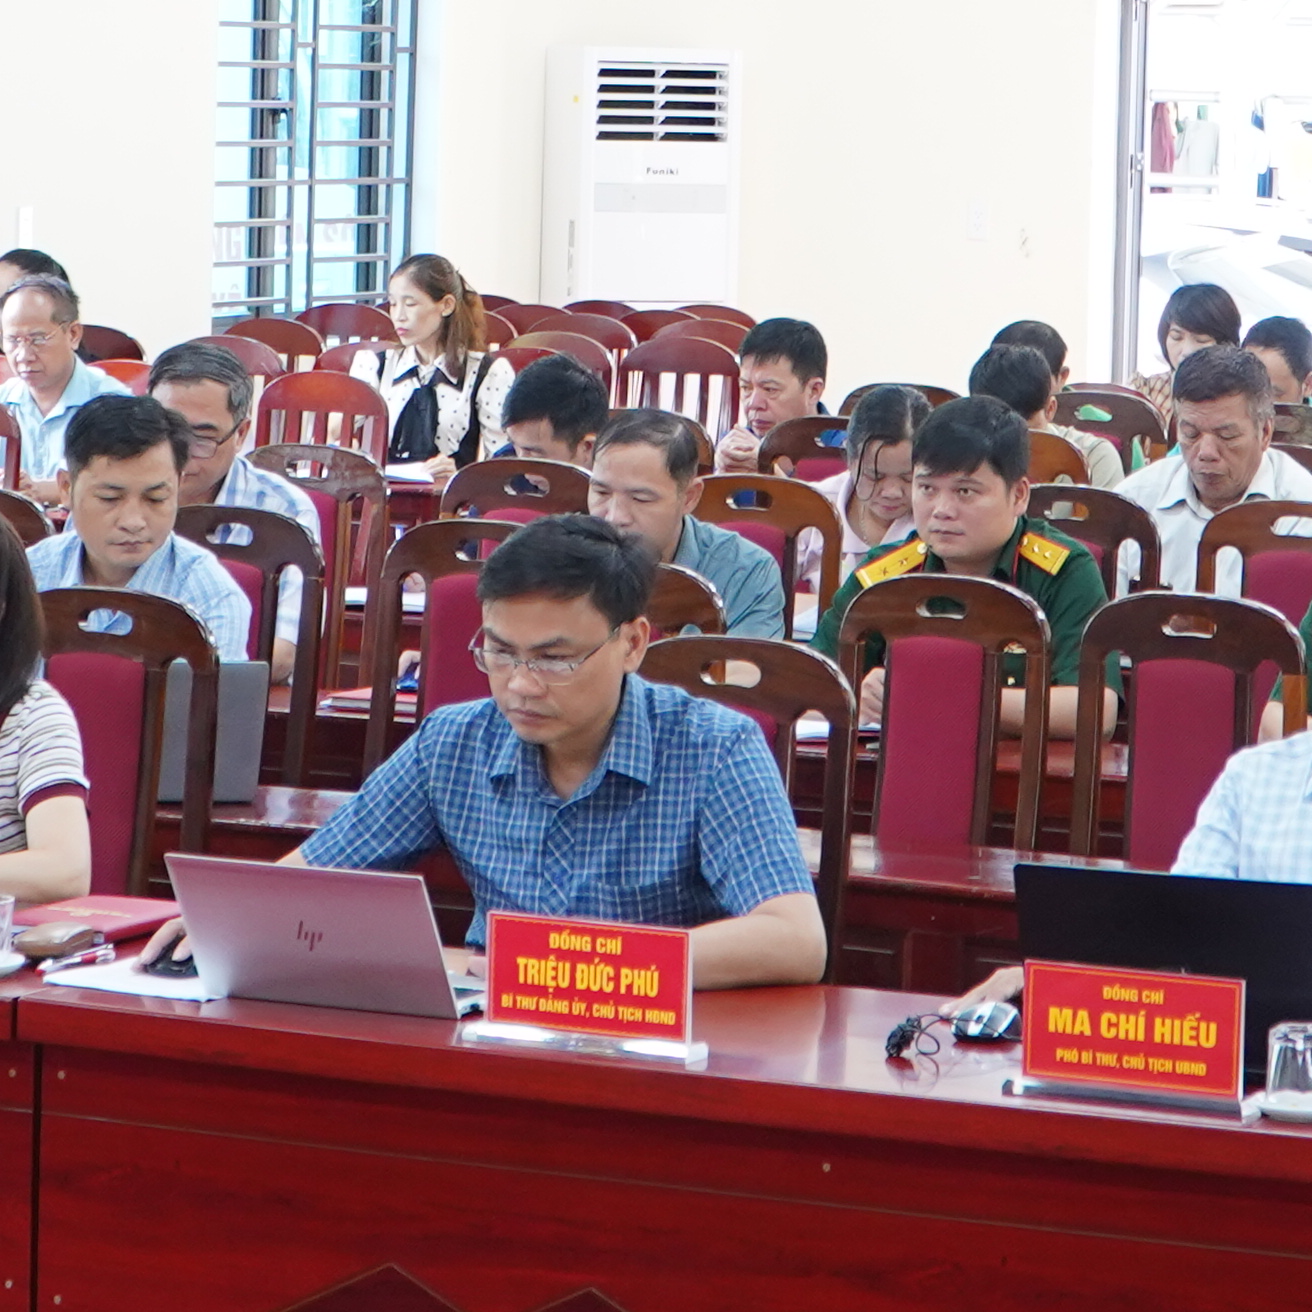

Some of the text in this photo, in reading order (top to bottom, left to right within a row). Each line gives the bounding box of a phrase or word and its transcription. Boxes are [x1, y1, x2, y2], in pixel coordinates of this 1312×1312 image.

[595, 936, 622, 956] CHÍ
[516, 954, 660, 998] TRIỆU ĐỨC PHÚ
[1141, 988, 1165, 1005] CHÍ
[617, 1006, 643, 1024] TỊCH
[1047, 1006, 1218, 1049] MA CHÍ HIẾU
[1055, 1047, 1079, 1064] PHÓ
[1147, 1057, 1173, 1075] TỊCH
[1175, 1060, 1208, 1077] UBND
